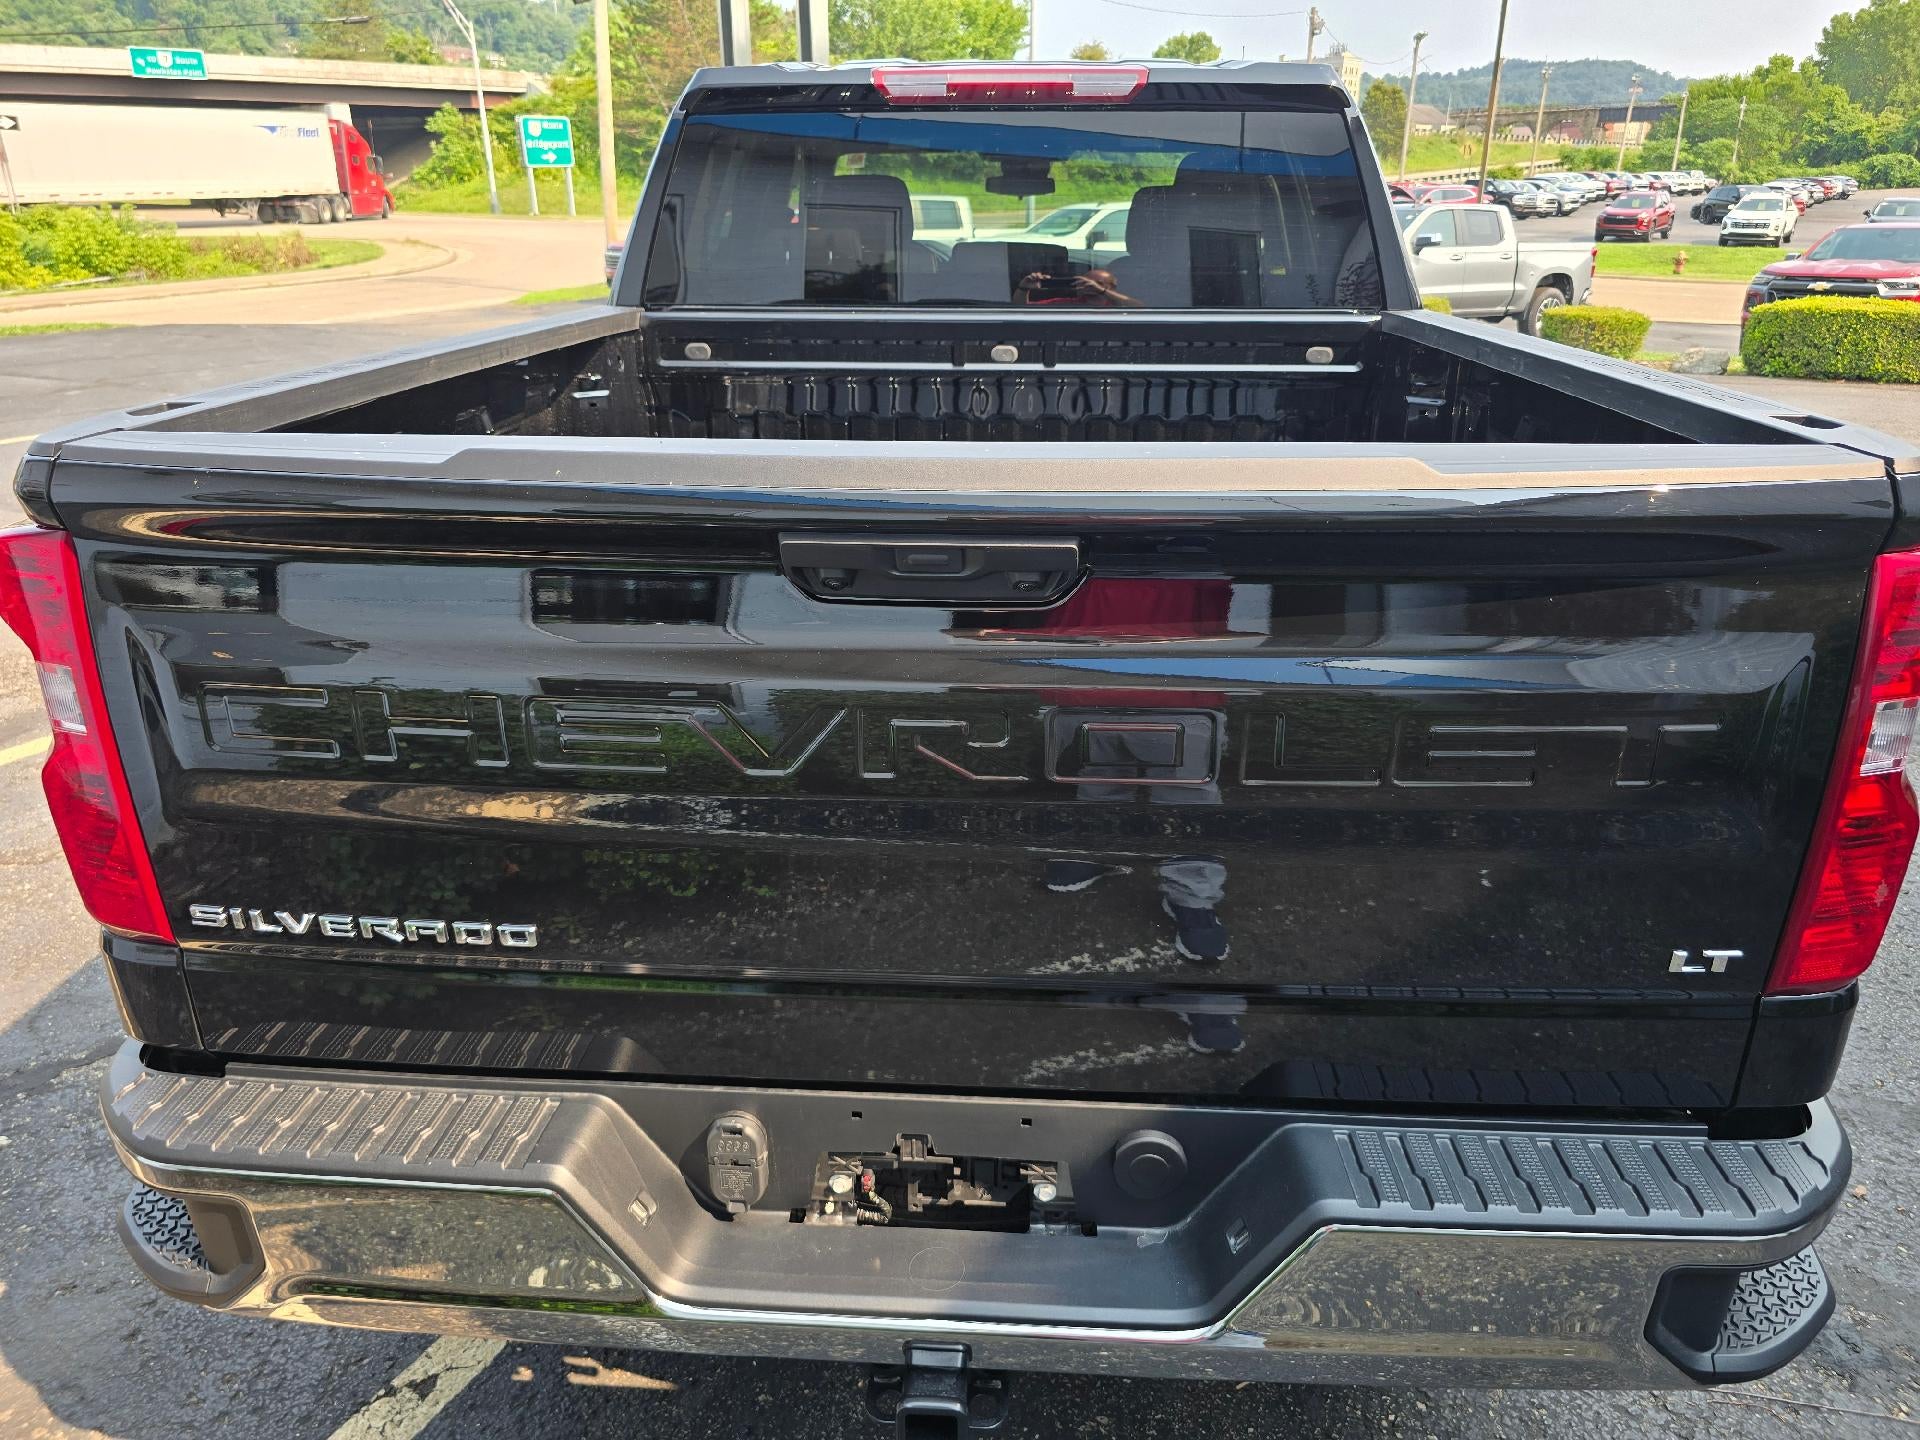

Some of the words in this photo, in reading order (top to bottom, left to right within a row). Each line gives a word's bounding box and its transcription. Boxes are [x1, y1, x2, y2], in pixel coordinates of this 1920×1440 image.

[200, 682, 1723, 788] CHEVROLET
[189, 903, 538, 948] SILVERADO
[1668, 950, 1744, 973] LT
